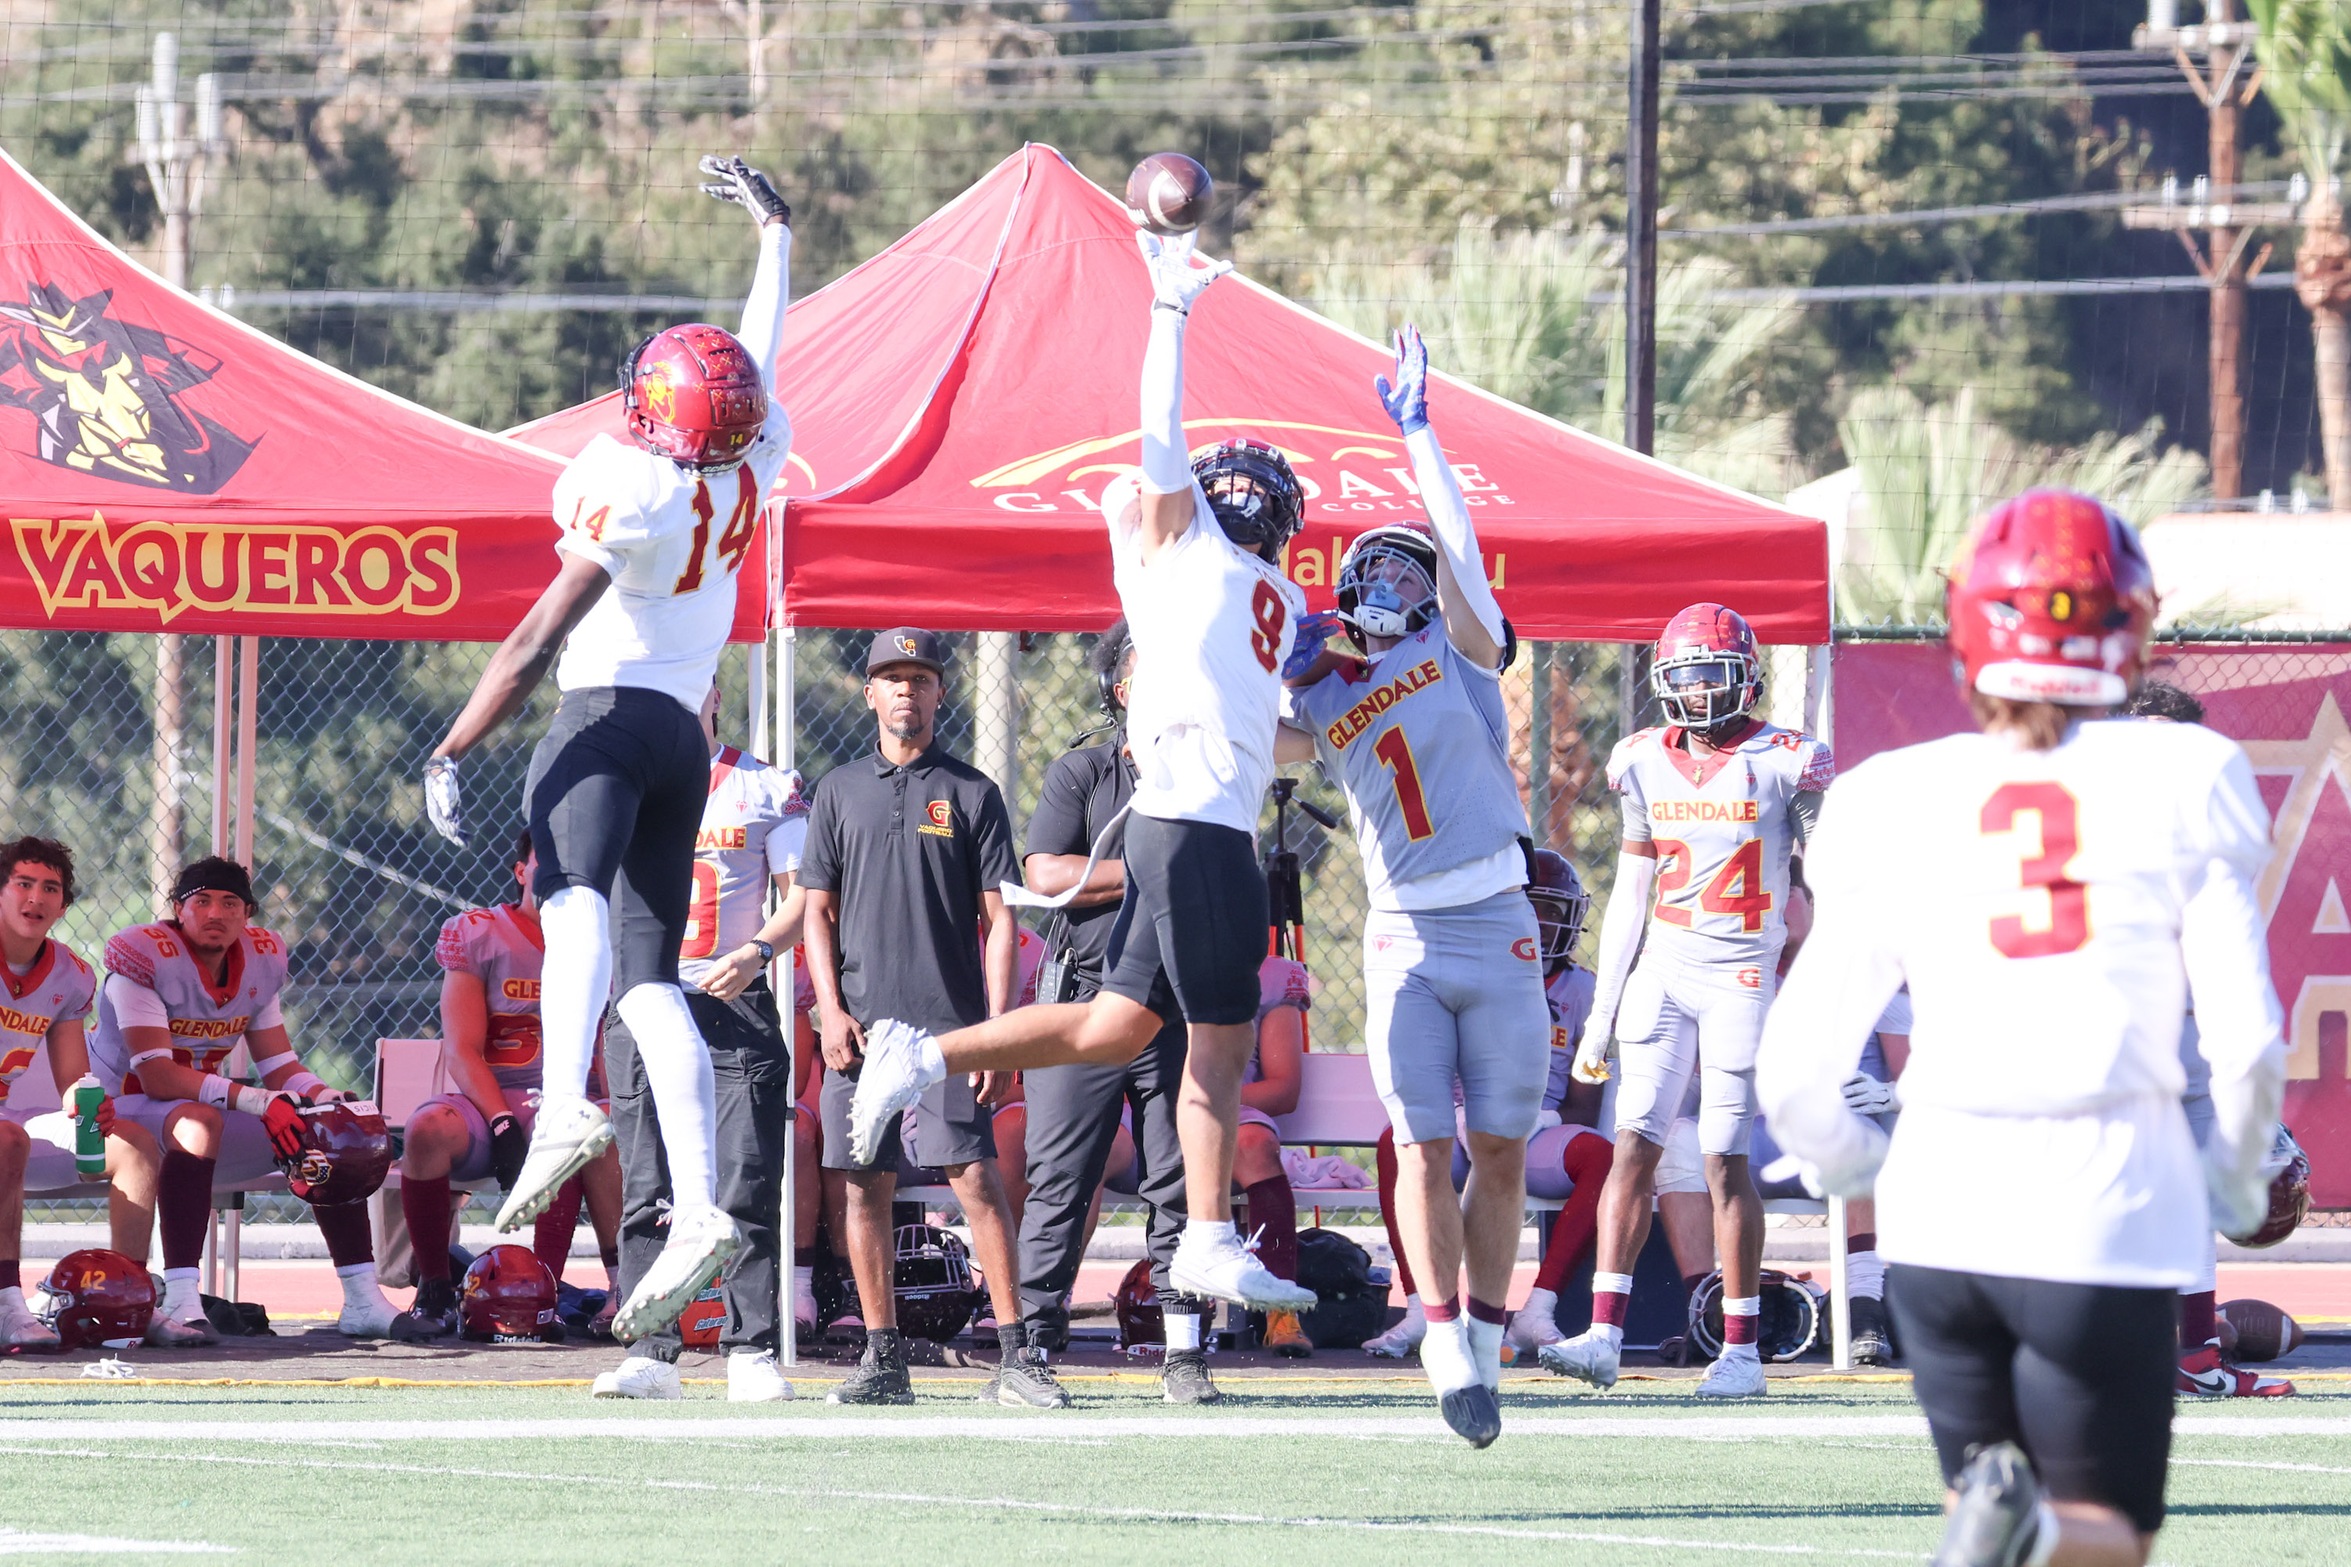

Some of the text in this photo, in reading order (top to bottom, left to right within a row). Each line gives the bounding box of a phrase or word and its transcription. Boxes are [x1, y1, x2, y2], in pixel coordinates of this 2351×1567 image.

[730, 433, 744, 446] 14
[569, 496, 612, 544] 14
[672, 460, 759, 597] 14
[1320, 494, 1516, 512] COLLGE
[9, 509, 461, 626] VAQUEROS
[1249, 576, 1287, 677] 9
[1326, 658, 1444, 751] GLENDALE
[925, 799, 951, 827] G
[1373, 722, 1437, 843] 1
[1651, 799, 1759, 823] GLENDALE
[1652, 837, 1773, 934] 24
[1979, 779, 2094, 960] 3
[168, 1015, 250, 1041] GLENDALE
[80, 1270, 106, 1291] 42
